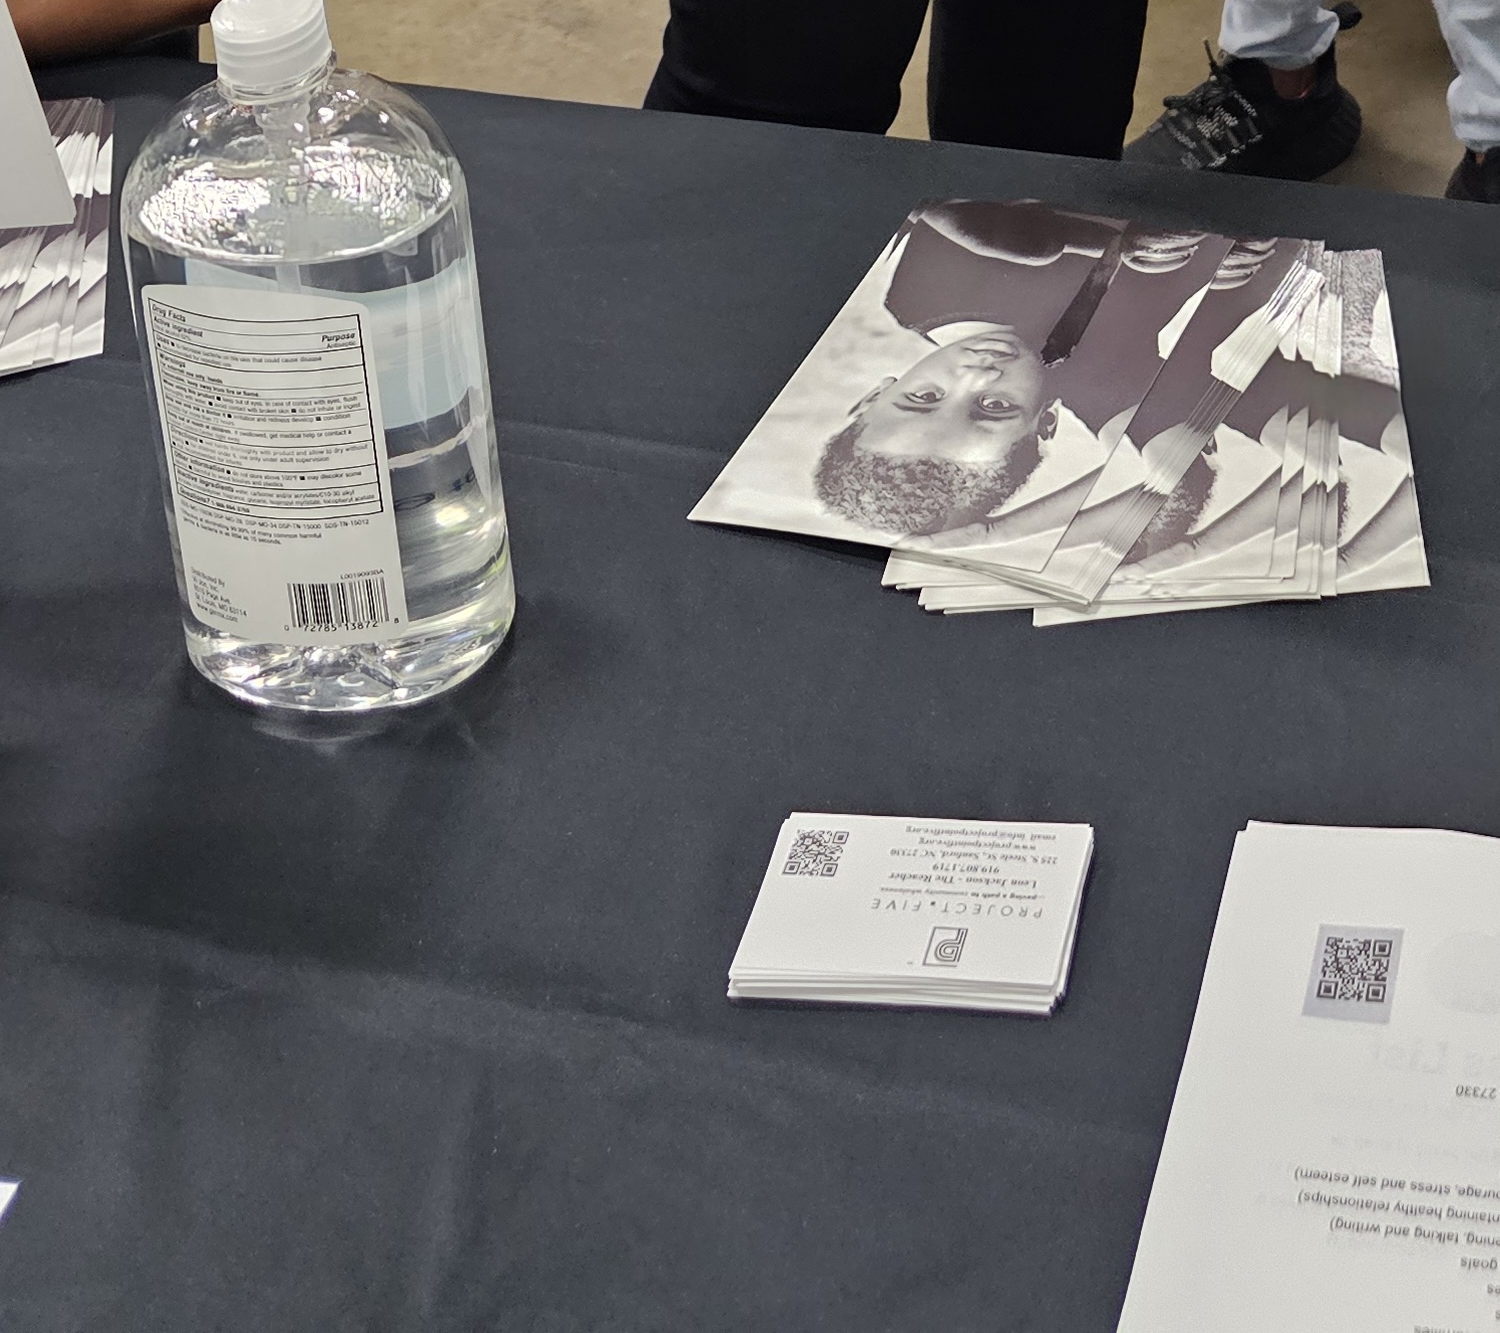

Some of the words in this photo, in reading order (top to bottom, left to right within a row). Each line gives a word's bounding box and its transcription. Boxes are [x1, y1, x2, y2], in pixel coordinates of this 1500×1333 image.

[151, 303, 166, 318] Drug
[168, 310, 186, 323] Facts
[321, 332, 356, 343] Purpose
[303, 623, 337, 632] 72785
[343, 620, 379, 631] 13872
[905, 826, 1026, 841] info@projectpointfive.org
[918, 837, 1036, 851] www.projectpointfive.org
[920, 849, 936, 858] NC
[940, 849, 980, 861] Sanford,
[1000, 853, 1026, 863] Steele
[932, 863, 1000, 874] 919.807.1719
[888, 872, 932, 883] Reacher
[936, 874, 954, 884] The
[965, 875, 1007, 887] Jackson
[1011, 879, 1037, 889] Leon
[1455, 1084, 1496, 1099] 27330
[1294, 1165, 1349, 1183] esteem)
[1352, 1174, 1377, 1188] self
[1380, 1177, 1406, 1191] and
[1410, 1181, 1450, 1196] stress
[1297, 1189, 1390, 1213] relationships)
[1393, 1200, 1442, 1219] healthy
[1330, 1216, 1381, 1234] writing)
[1383, 1224, 1410, 1238] and
[1414, 1226, 1459, 1243] talking
[1460, 1257, 1498, 1271] goals
